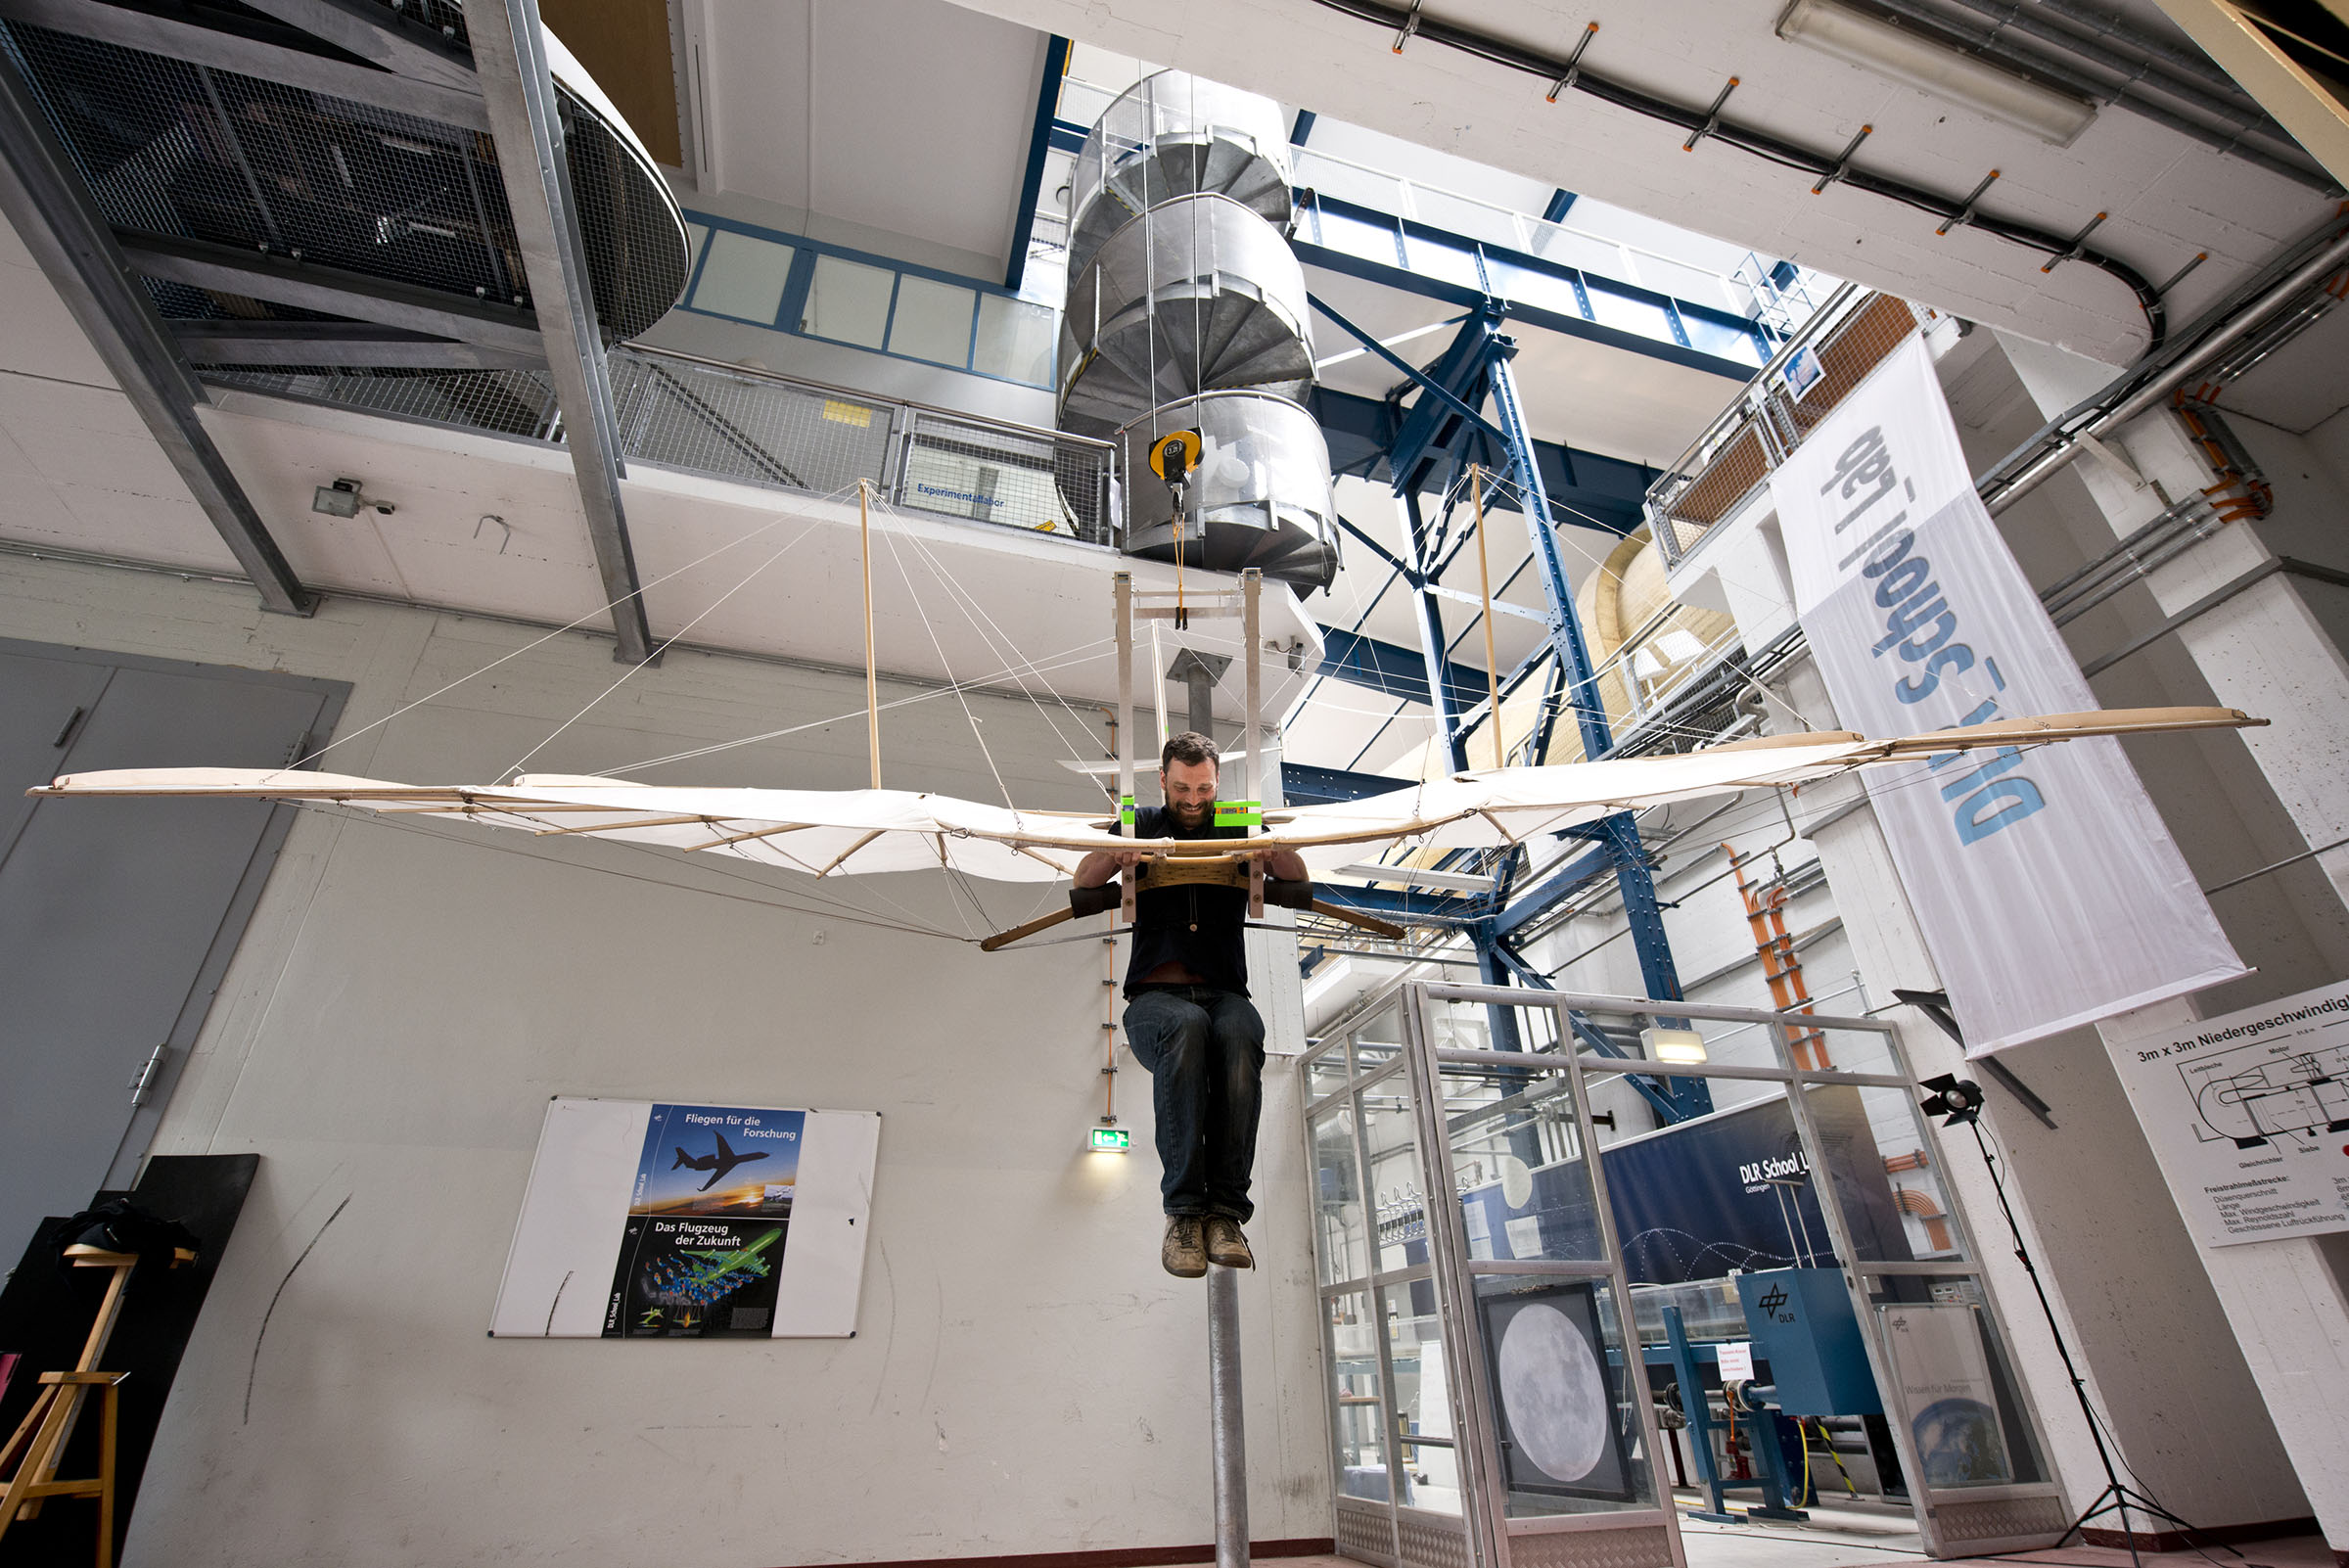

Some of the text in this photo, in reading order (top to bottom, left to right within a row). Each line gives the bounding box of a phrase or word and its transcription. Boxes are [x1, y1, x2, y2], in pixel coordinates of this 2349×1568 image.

[917, 483, 1005, 508] Experimentallabor
[2138, 994, 2349, 1063] 3m x 3m Niedergeschwindig
[685, 1113, 760, 1127] Fliegen für die
[743, 1128, 797, 1141] Forschung
[1738, 1150, 1811, 1184] DLR_School_L
[1745, 1183, 1771, 1194] Göttingen
[655, 1222, 729, 1236] Das Flugzeug
[674, 1234, 741, 1247] der Zukunft
[1777, 1313, 1796, 1324] DLR
